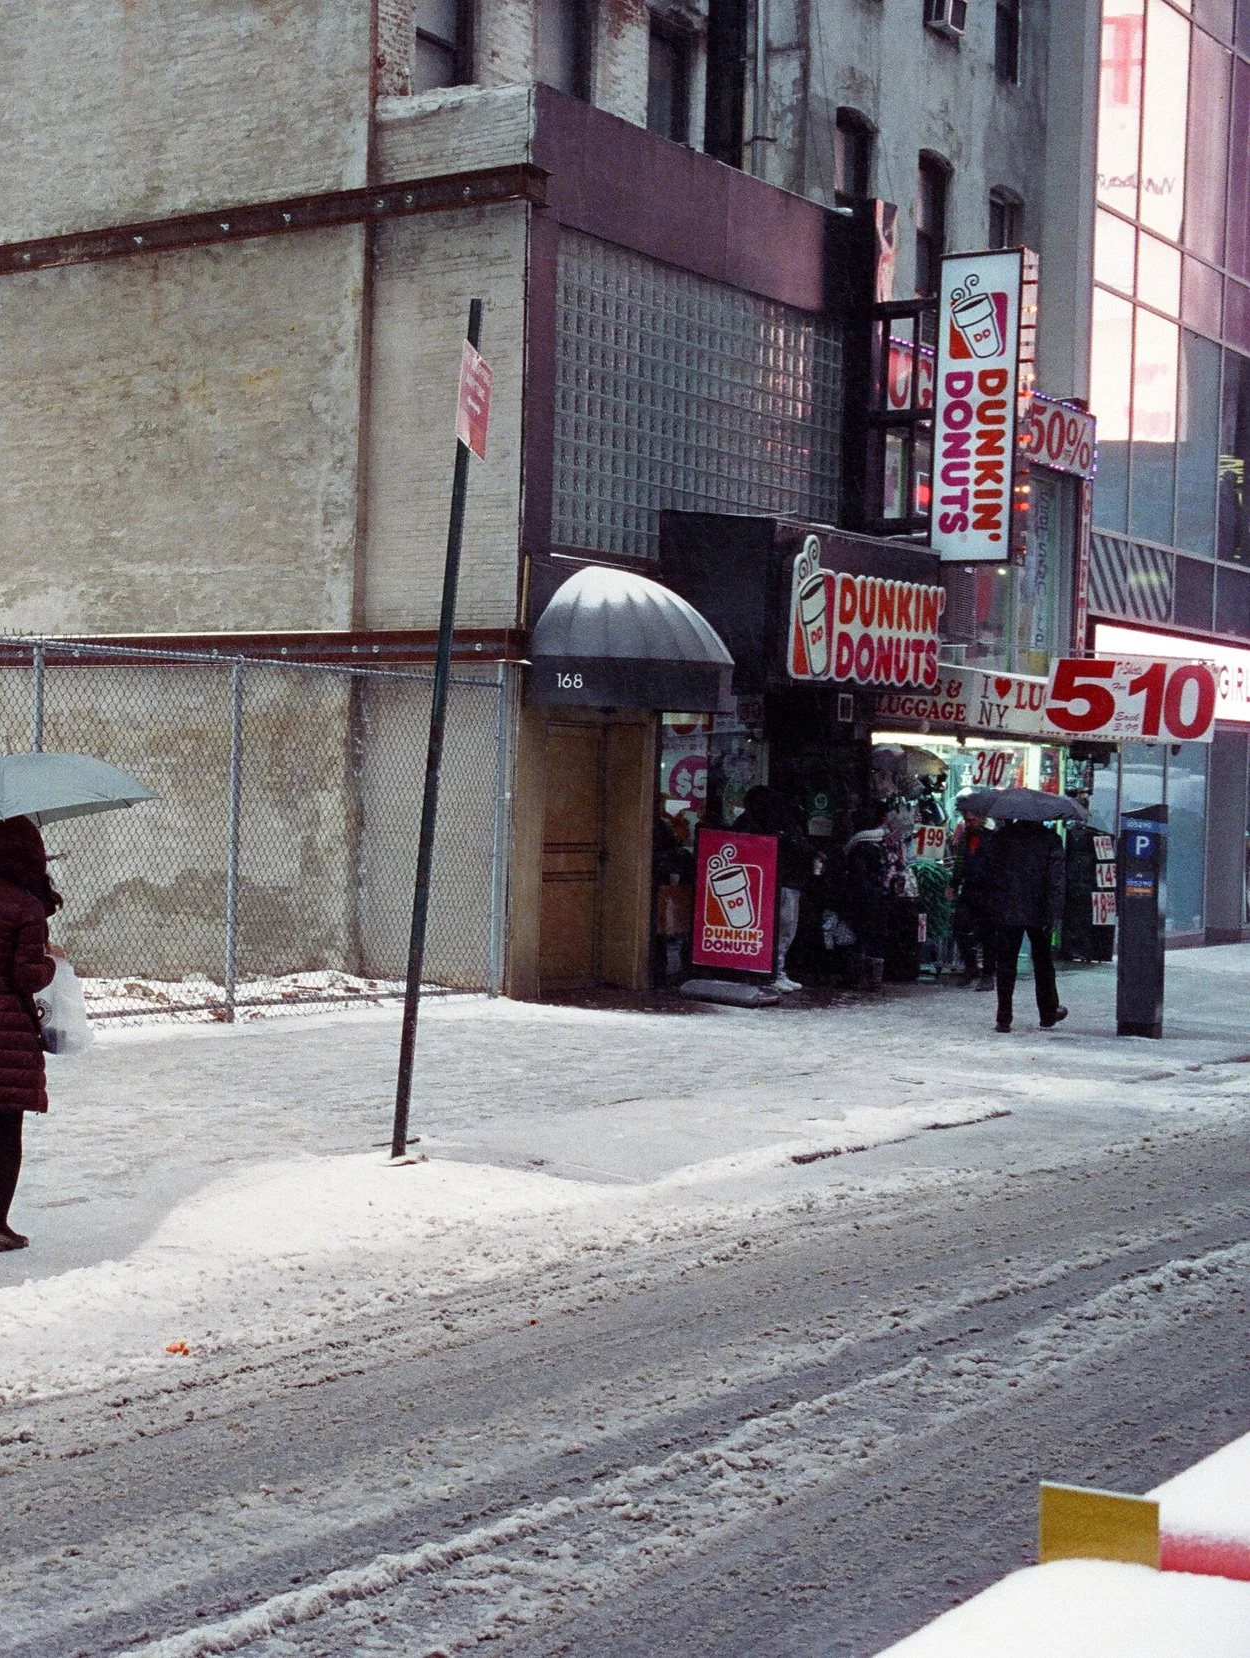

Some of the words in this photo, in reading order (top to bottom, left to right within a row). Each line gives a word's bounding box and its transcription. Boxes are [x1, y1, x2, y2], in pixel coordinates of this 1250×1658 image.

[974, 329, 991, 342] DD
[1029, 402, 1091, 470] 50%
[938, 371, 974, 534] DONUTS
[972, 368, 1008, 542] DUNKIN'
[839, 574, 946, 634] DUNKIN'
[834, 632, 938, 688] DONUTS
[556, 673, 583, 689] 168
[875, 694, 967, 722] LUGGAGE
[1014, 682, 1047, 711] LU
[1045, 658, 1116, 732] 5
[1128, 662, 1215, 740] 10
[1135, 835, 1150, 856] P
[702, 939, 760, 955] DONUTS
[703, 926, 763, 942] DUNKIN'
